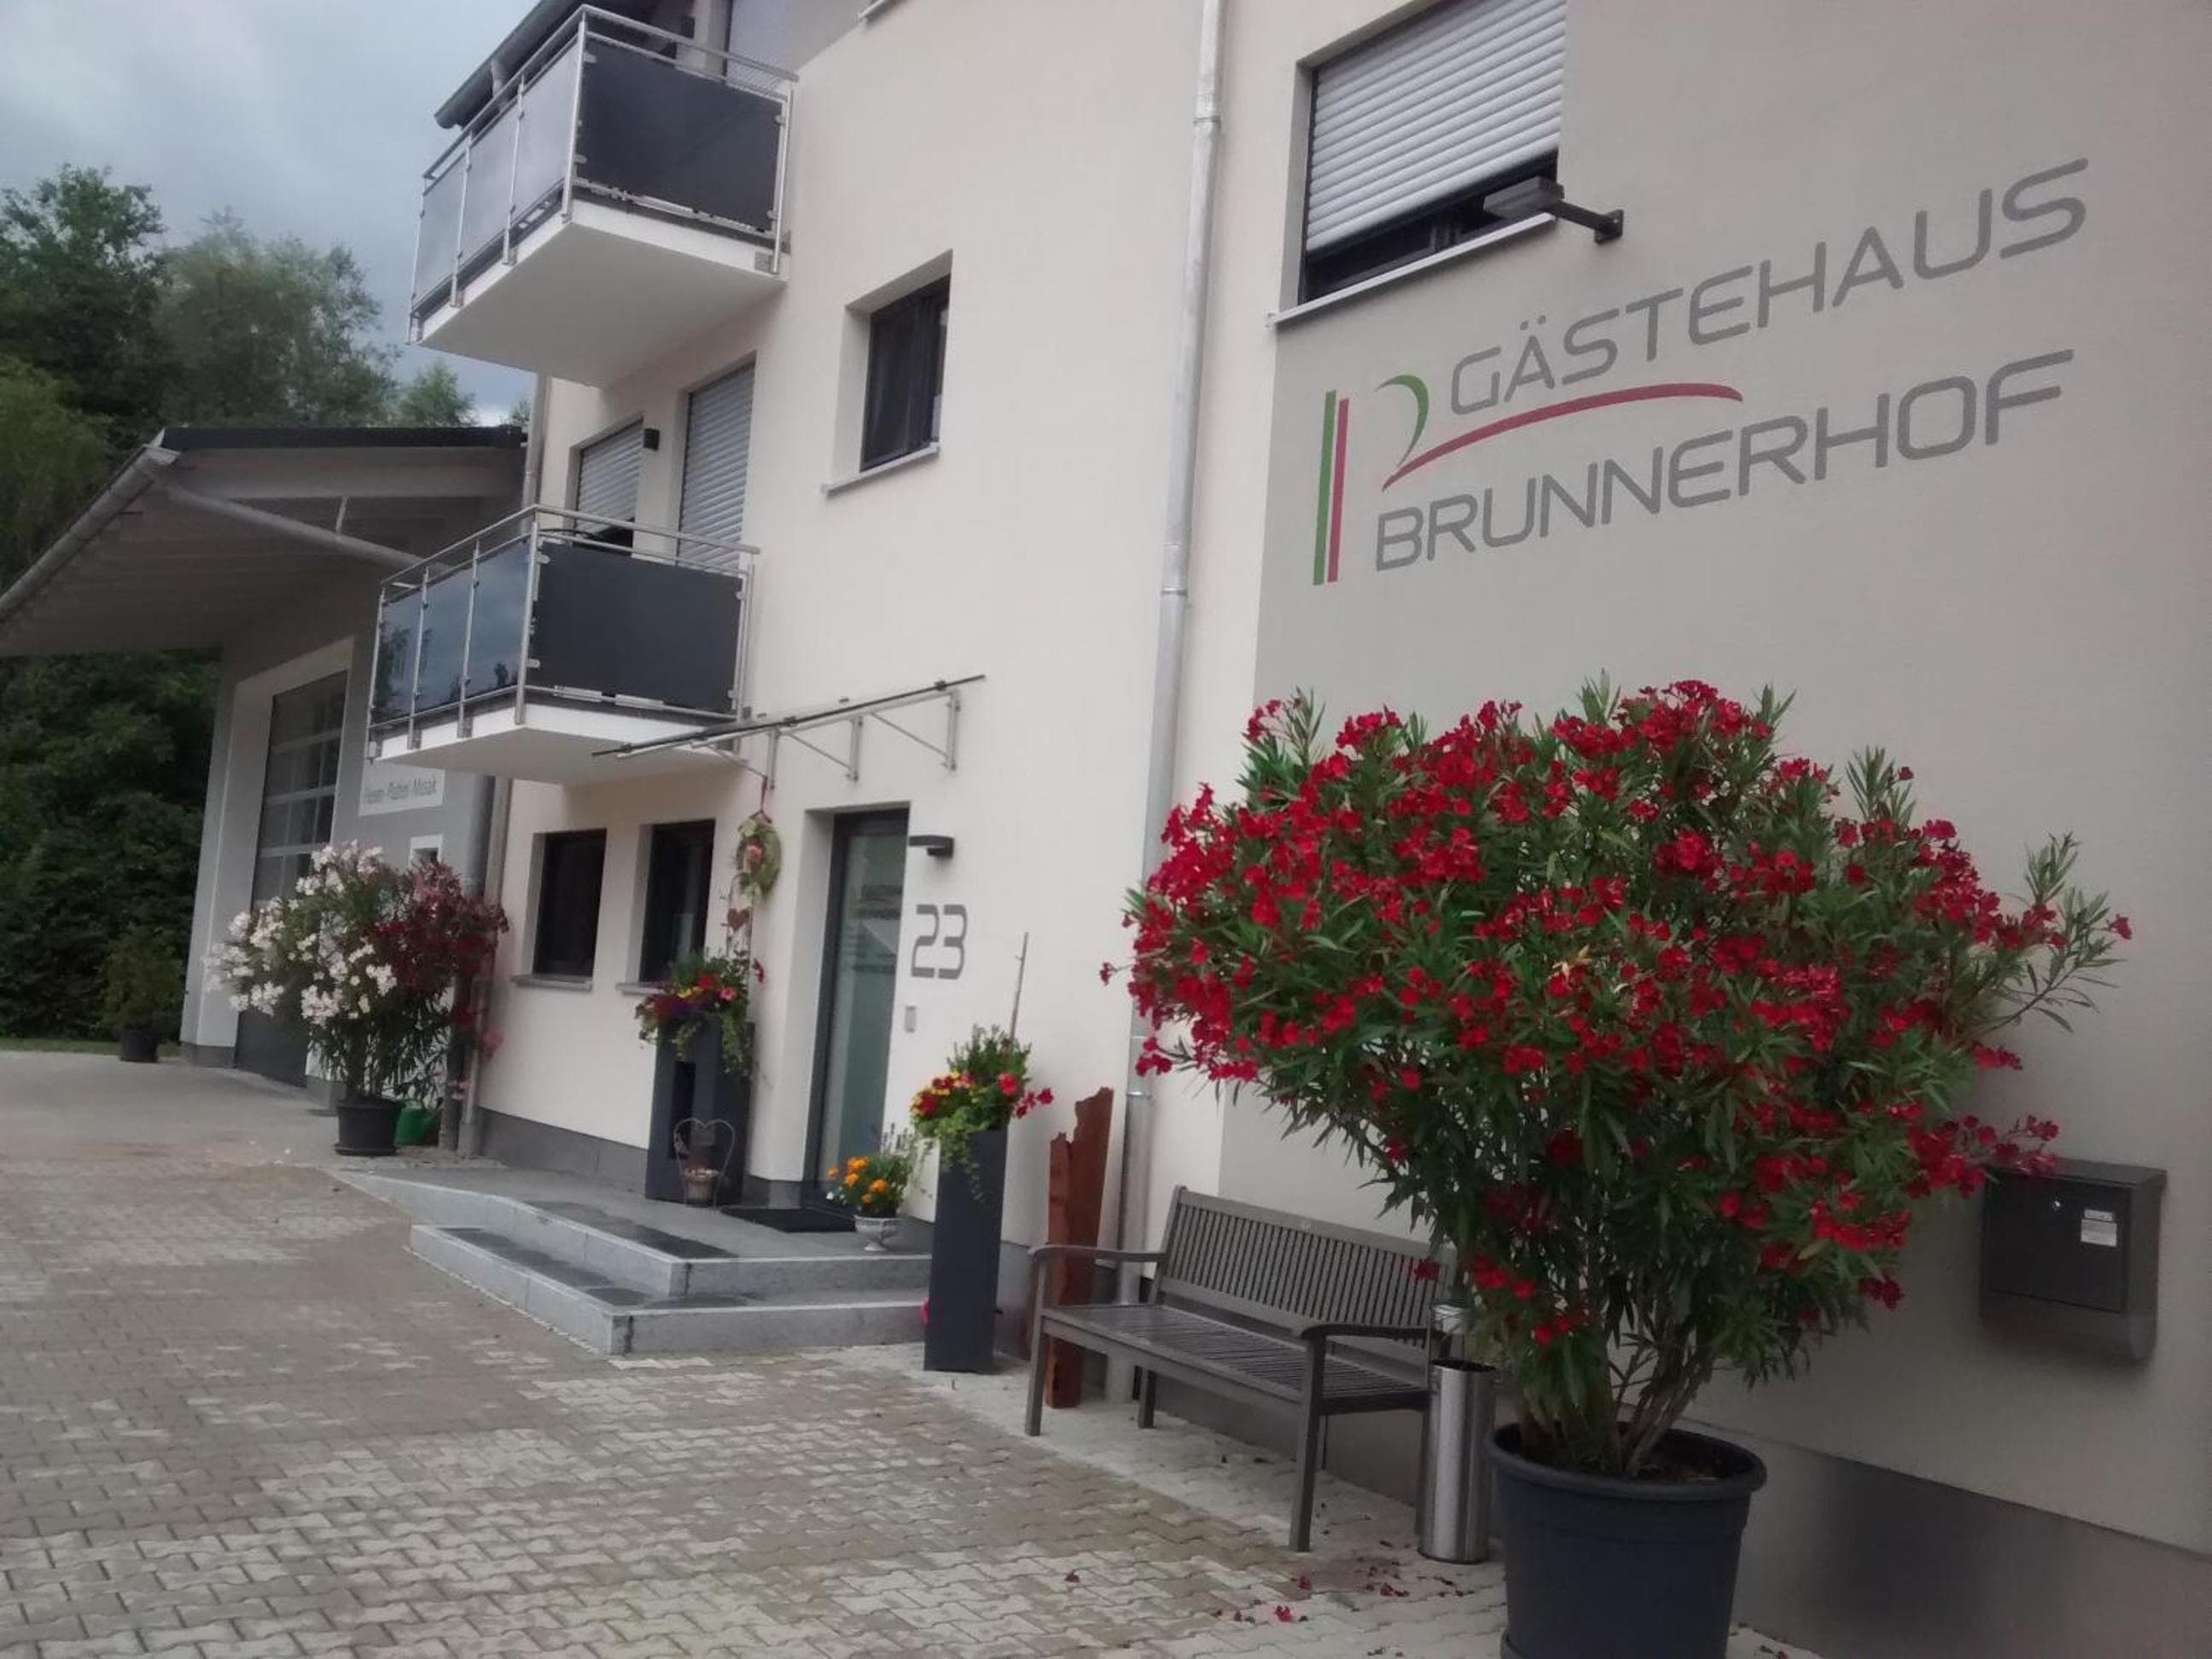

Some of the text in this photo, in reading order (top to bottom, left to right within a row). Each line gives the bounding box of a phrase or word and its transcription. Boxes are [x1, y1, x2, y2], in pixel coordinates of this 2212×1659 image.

[1450, 158, 2089, 416] GÄSTEHAUS
[1375, 349, 2075, 572] BRUNNERHOF
[911, 904, 968, 980] 23
